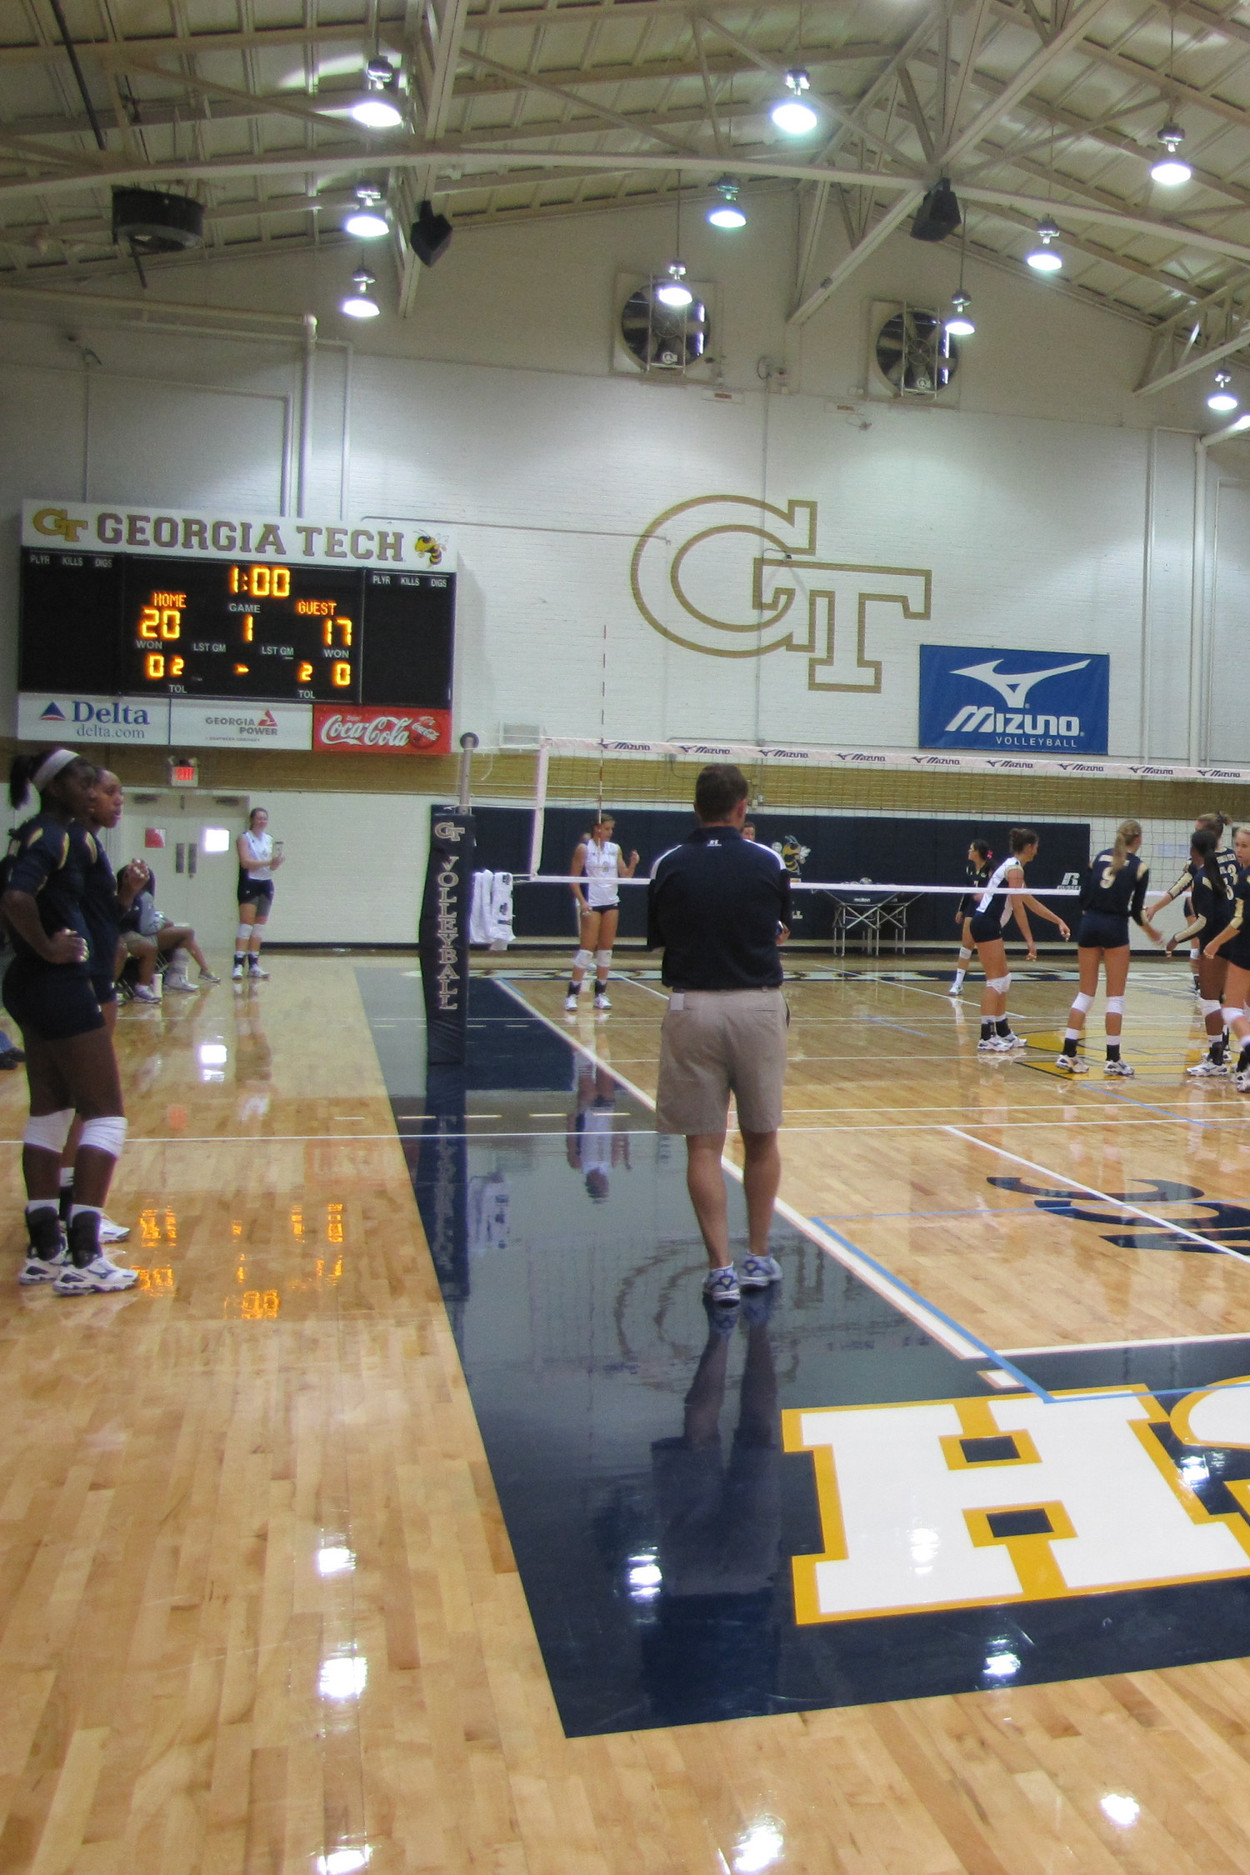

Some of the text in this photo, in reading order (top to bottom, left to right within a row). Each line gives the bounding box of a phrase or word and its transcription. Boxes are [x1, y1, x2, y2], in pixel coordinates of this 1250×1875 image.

[33, 508, 88, 542] GT
[97, 512, 405, 562] GEORGIA TECH
[30, 555, 112, 568] PLYR KILLS DIGS
[232, 567, 290, 597] 1:00
[373, 575, 447, 588] PLYR KILLS DIGS
[153, 592, 187, 608] HOME
[631, 494, 932, 693] GT
[229, 602, 261, 613] GAME
[297, 601, 337, 615] GUEST
[141, 608, 181, 639] 20
[246, 614, 254, 642] 1
[325, 618, 353, 646] 17
[136, 640, 163, 650] WON
[193, 643, 226, 652] LST GM
[262, 646, 294, 655] LST GM
[323, 649, 350, 658] WON
[148, 655, 165, 678] 0
[171, 657, 185, 675] 2
[300, 663, 313, 681] 2
[335, 663, 351, 686] 0
[169, 684, 187, 694] TOL
[298, 690, 315, 699] TOL
[72, 701, 150, 725] Delta
[205, 717, 256, 726] GEORGIA
[944, 705, 1080, 737] Mizuno
[76, 724, 145, 739] delta.com
[239, 727, 278, 736] POWER
[321, 714, 413, 747] Coca-Cola
[995, 736, 1077, 748] VOLLEYBALL
[434, 821, 465, 842] GT
[437, 856, 461, 1010] VOLLEYBALL
